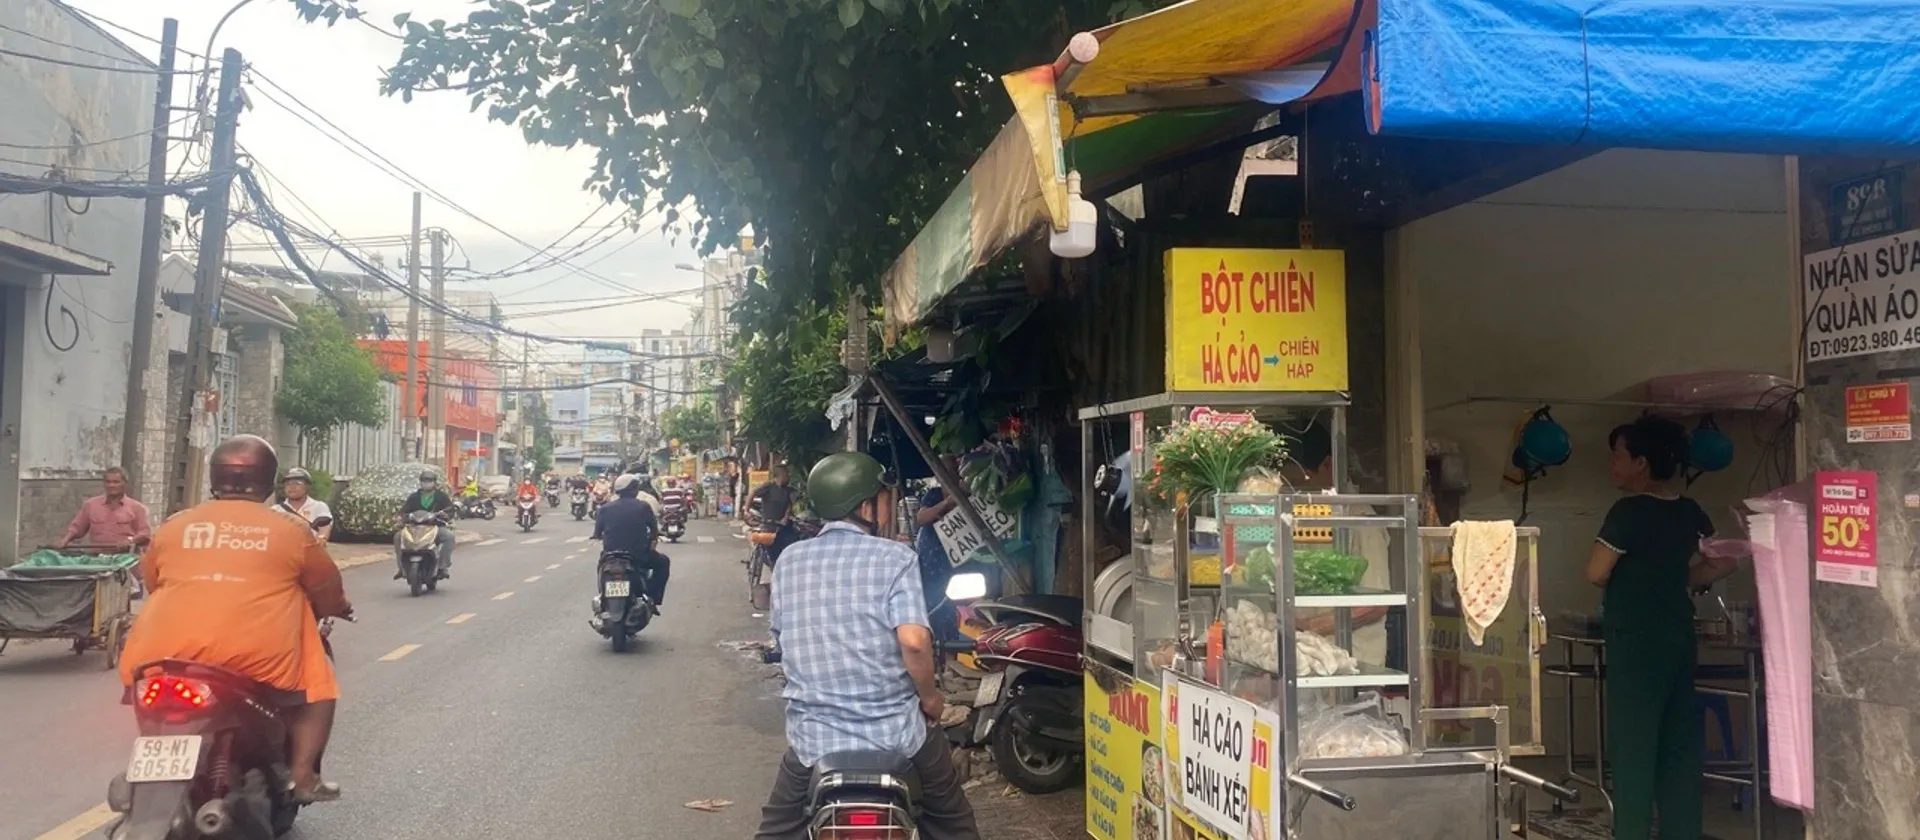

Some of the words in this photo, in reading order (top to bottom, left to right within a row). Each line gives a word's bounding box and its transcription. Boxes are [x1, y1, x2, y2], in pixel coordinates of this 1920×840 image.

[1809, 251, 1868, 293] NHẬN
[1201, 258, 1244, 327] BỘT
[1250, 258, 1315, 313] CHIÊN
[1884, 283, 1919, 322] ÁO
[1202, 331, 1224, 384] HÁ
[1227, 329, 1260, 384] CẢO
[1279, 336, 1319, 356] CHIÊN
[216, 534, 269, 551] Food
[220, 521, 270, 536] Shopee
[142, 739, 189, 757] 59-N1
[1192, 697, 1210, 748] HÁ
[1214, 706, 1243, 762] CẢO
[132, 759, 191, 778] 605.64
[1185, 751, 1220, 811] BÁNH
[1223, 772, 1248, 825] XẾP
